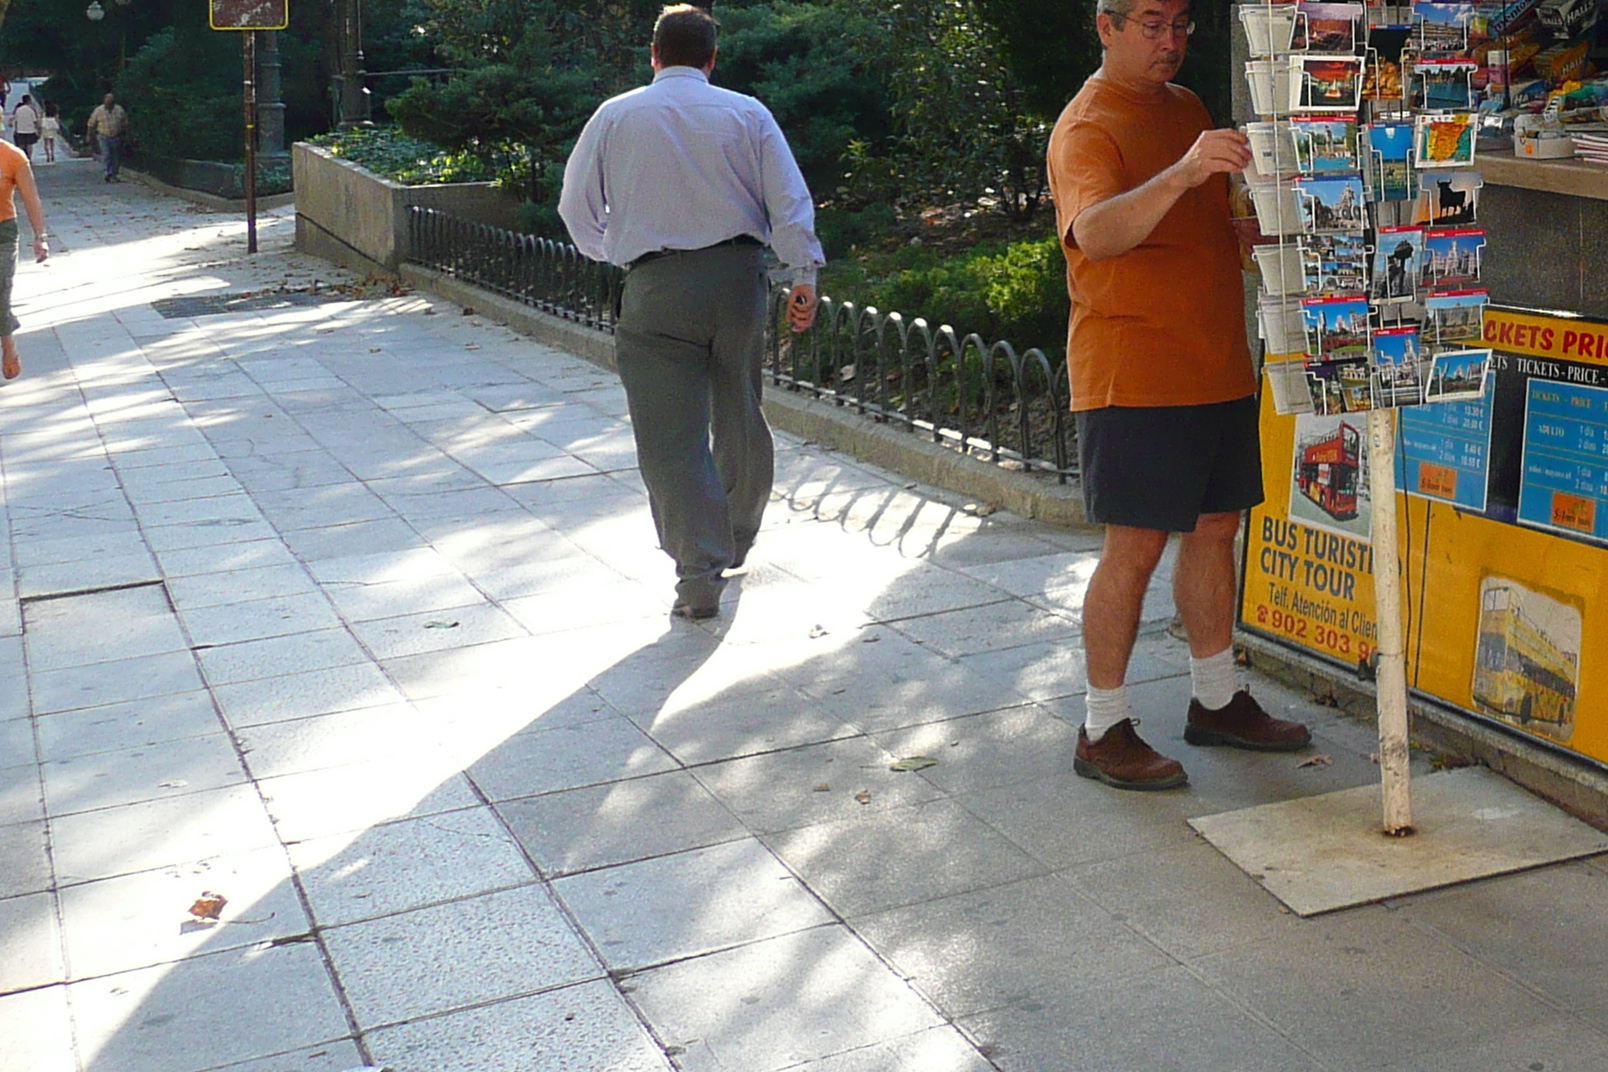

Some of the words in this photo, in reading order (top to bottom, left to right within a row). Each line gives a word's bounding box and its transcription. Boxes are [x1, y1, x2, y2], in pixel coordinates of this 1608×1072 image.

[1483, 320, 1555, 351] CKETS
[1517, 357, 1560, 378] TICKETS
[1567, 365, 1599, 384] PRICE
[1262, 515, 1298, 551] BUS
[1260, 547, 1299, 581] CITY
[1303, 560, 1355, 601] TOUR
[1269, 582, 1289, 608] Telf.
[1292, 590, 1337, 627] Atención
[1339, 608, 1349, 630] al
[1351, 610, 1378, 641] Clien
[1272, 610, 1308, 639] 902
[1314, 625, 1351, 655] 303
